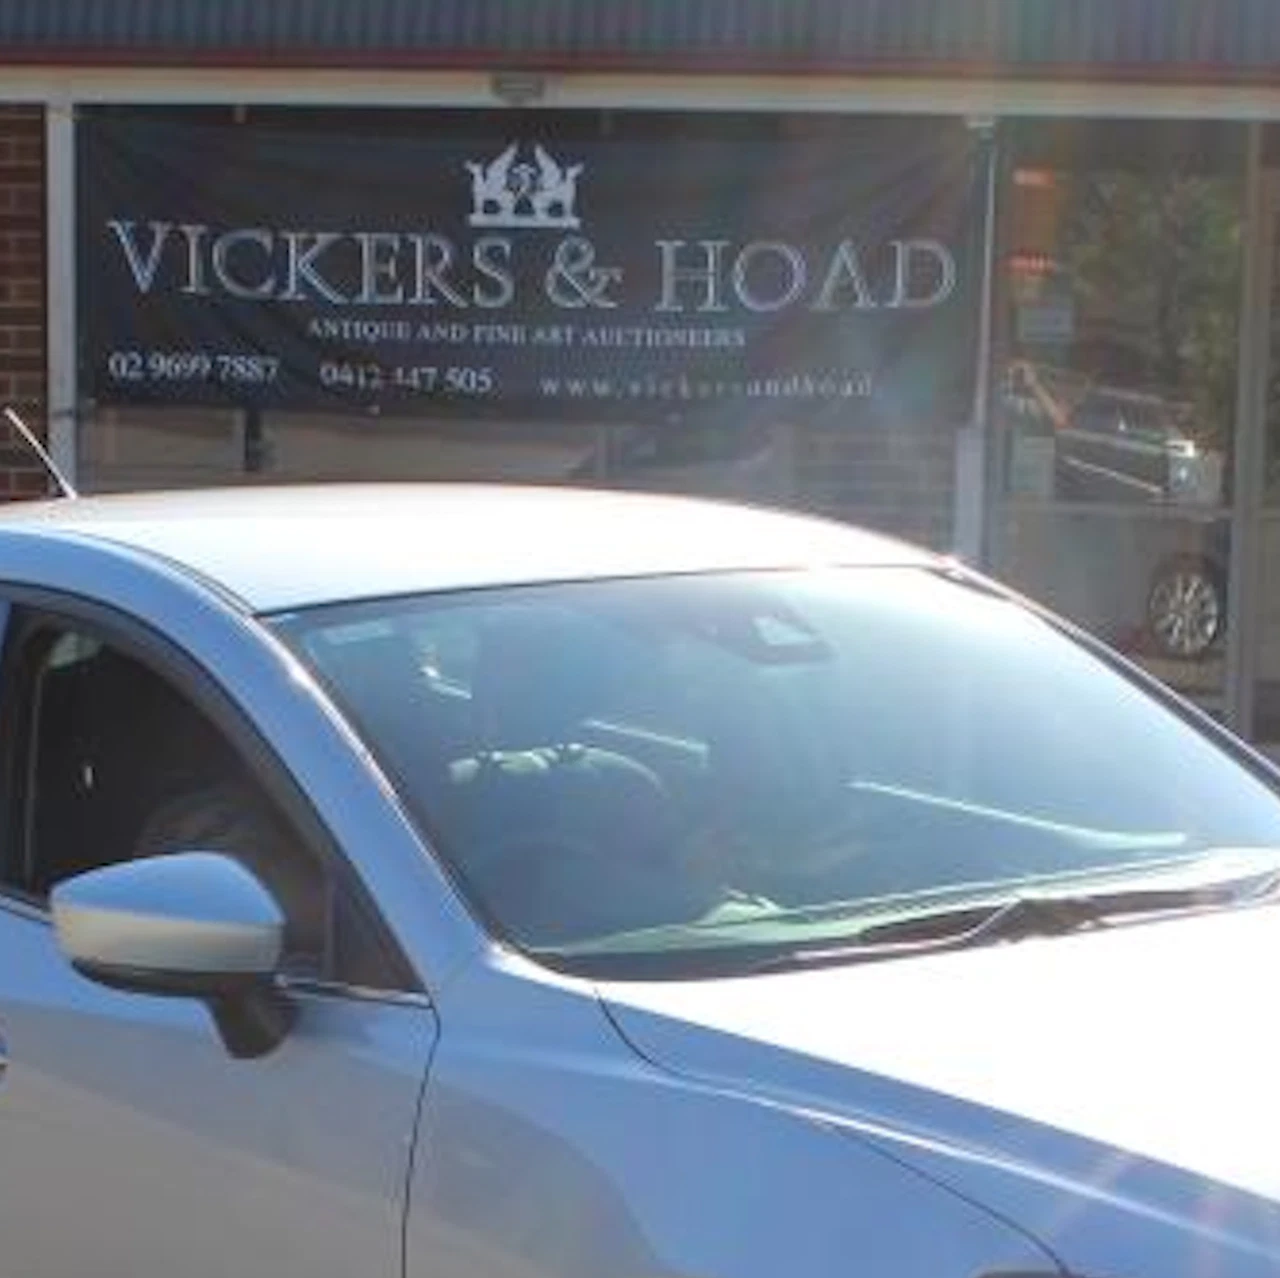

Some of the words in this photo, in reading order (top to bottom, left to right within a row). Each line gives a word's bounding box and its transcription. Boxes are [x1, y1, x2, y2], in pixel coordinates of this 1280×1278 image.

[107, 219, 516, 309] VICKERS
[544, 235, 624, 309] &
[653, 238, 957, 313] HOAD
[307, 318, 411, 342] ANTIQUE
[415, 324, 470, 343] AND
[473, 324, 526, 345] FINE
[581, 326, 746, 348] AUCTIONEERS
[108, 351, 144, 380] 02
